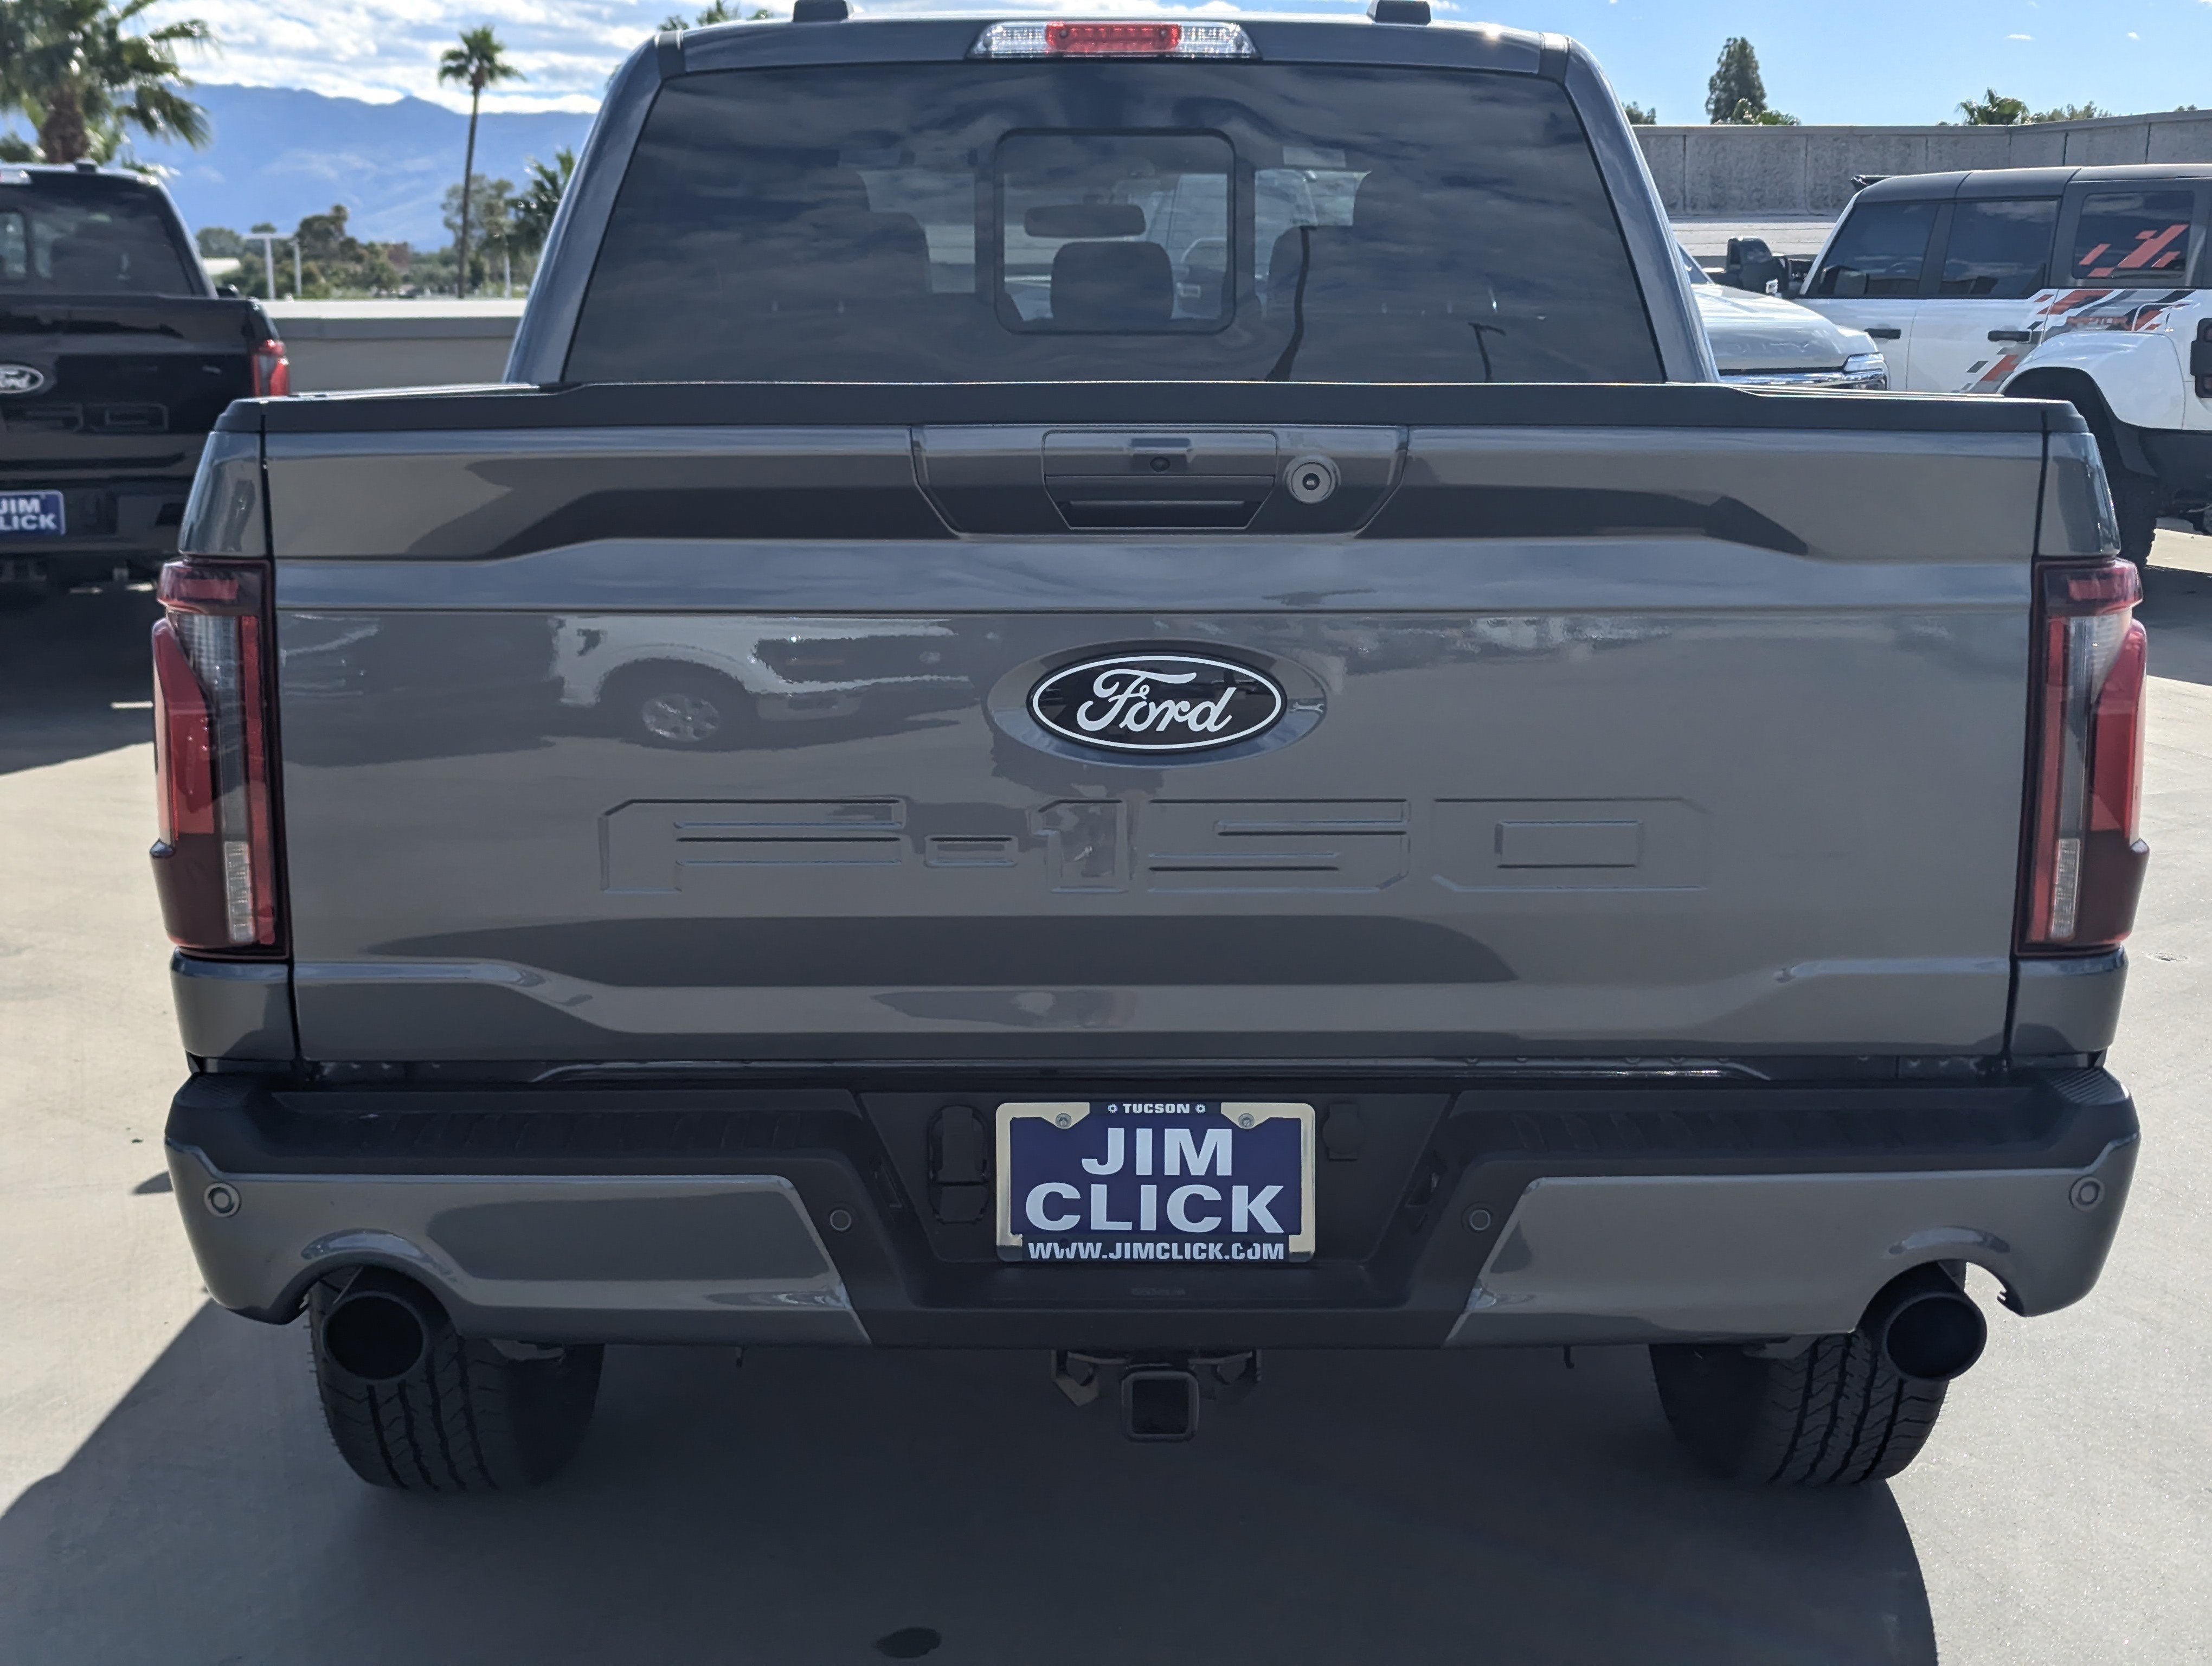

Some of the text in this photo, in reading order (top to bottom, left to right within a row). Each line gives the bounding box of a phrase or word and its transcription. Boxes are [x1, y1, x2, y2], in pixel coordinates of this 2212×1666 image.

[0, 370, 30, 389] ord
[0, 513, 57, 530] LICK
[1076, 669, 1237, 732] Ford
[598, 797, 1711, 893] F-150
[1122, 1103, 1191, 1114] TUCSON
[1081, 1127, 1232, 1176] JIM
[1025, 1182, 1285, 1233] CLICK
[1028, 1242, 1285, 1260] WWW.JIMCLICK.COM
